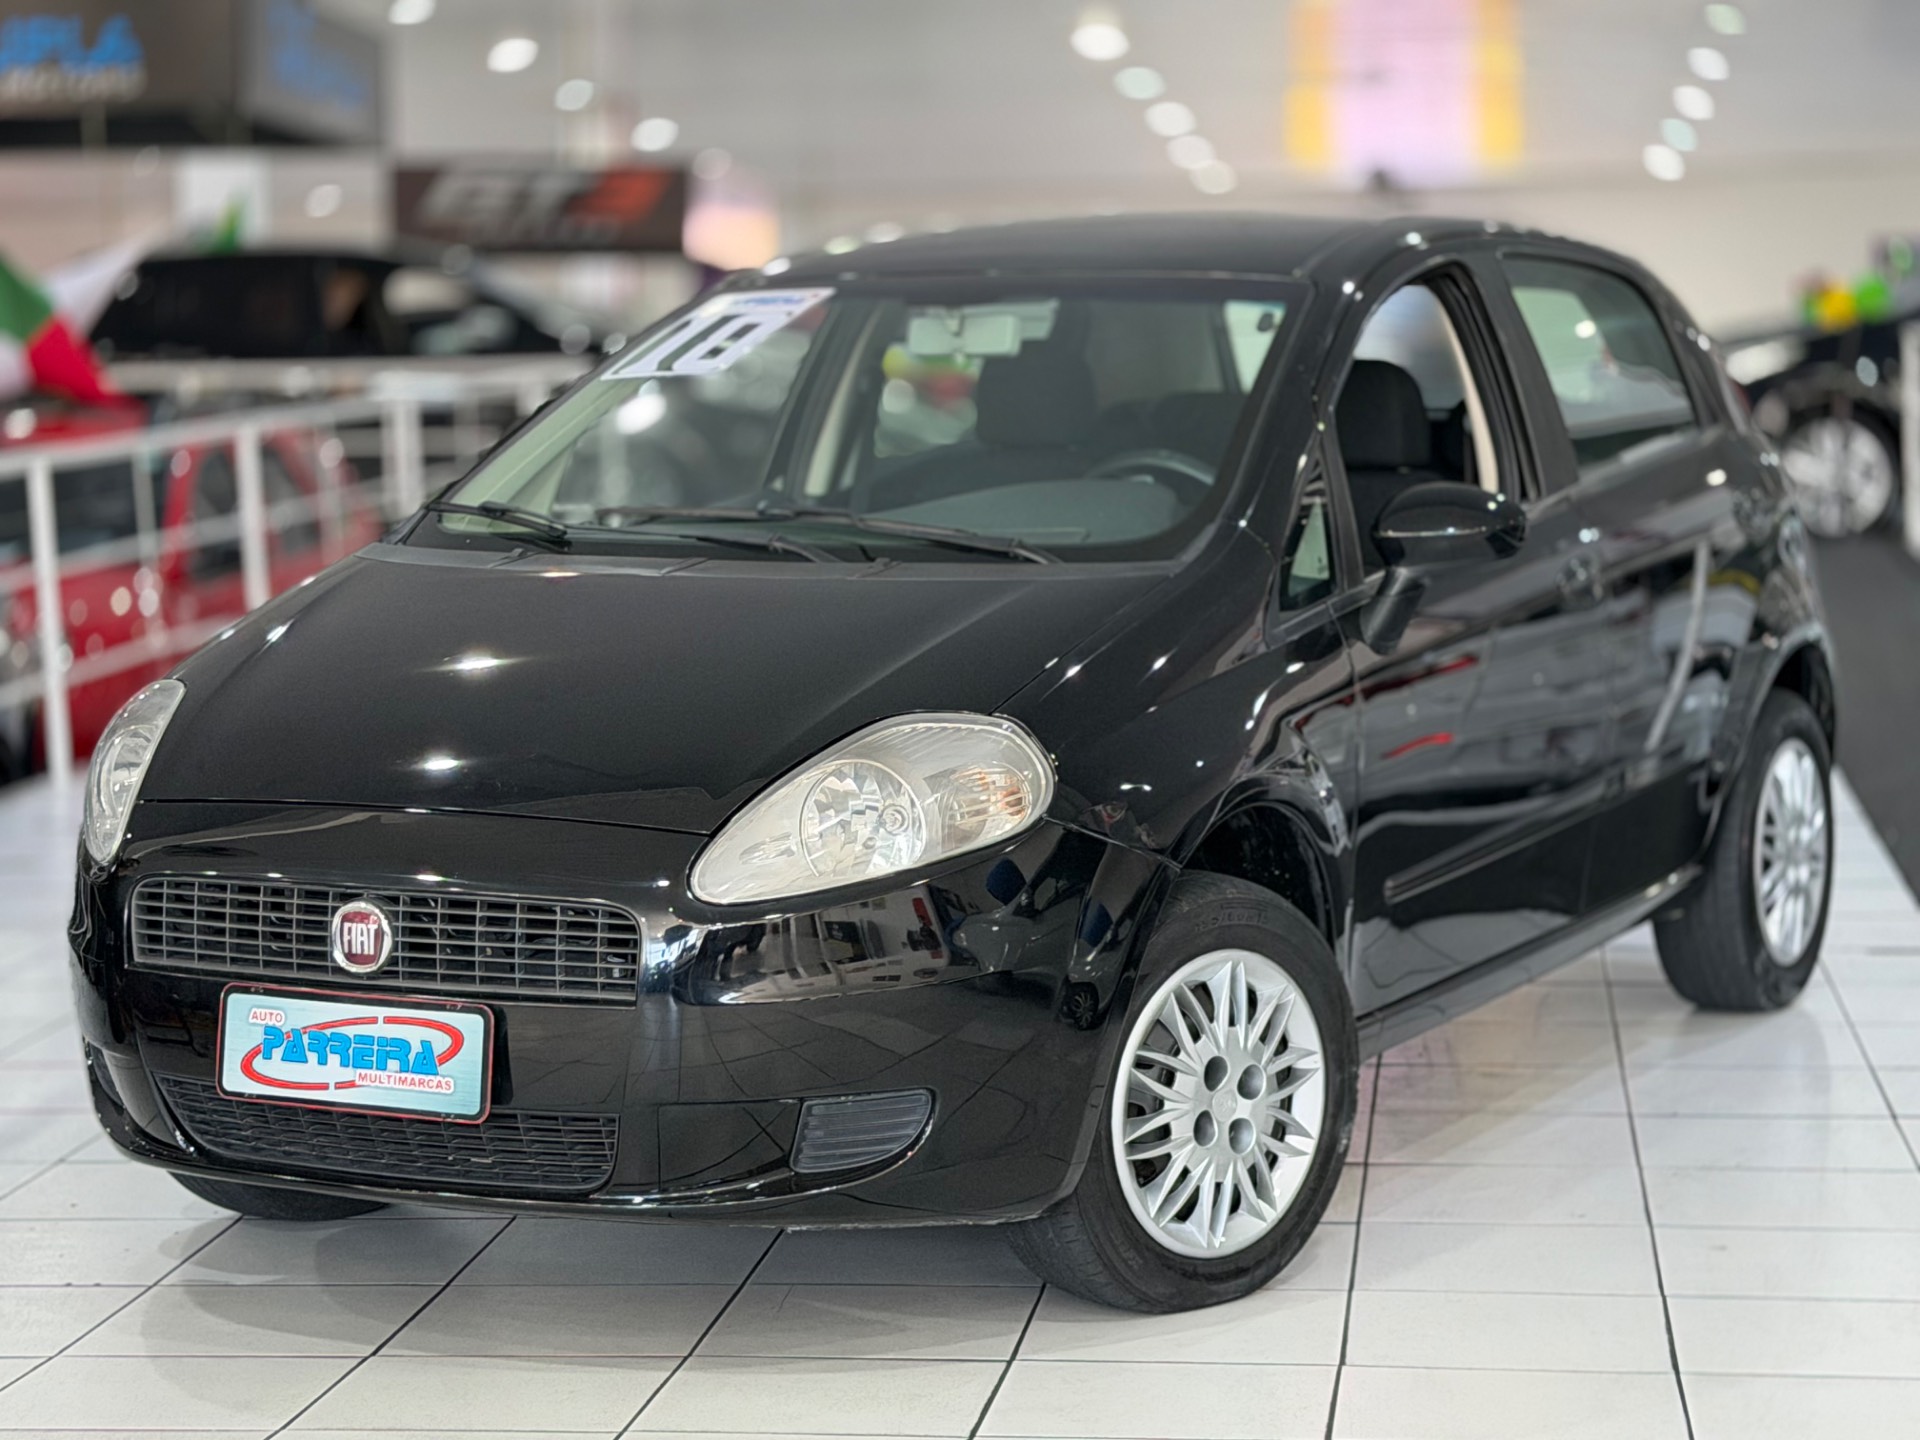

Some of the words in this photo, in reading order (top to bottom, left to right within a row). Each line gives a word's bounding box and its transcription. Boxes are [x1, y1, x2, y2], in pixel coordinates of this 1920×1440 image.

[343, 921, 379, 955] FIAT
[251, 1010, 283, 1023] AUTO
[261, 1025, 439, 1075] PARREIRA
[358, 1072, 452, 1091] MULTIMARCAS
